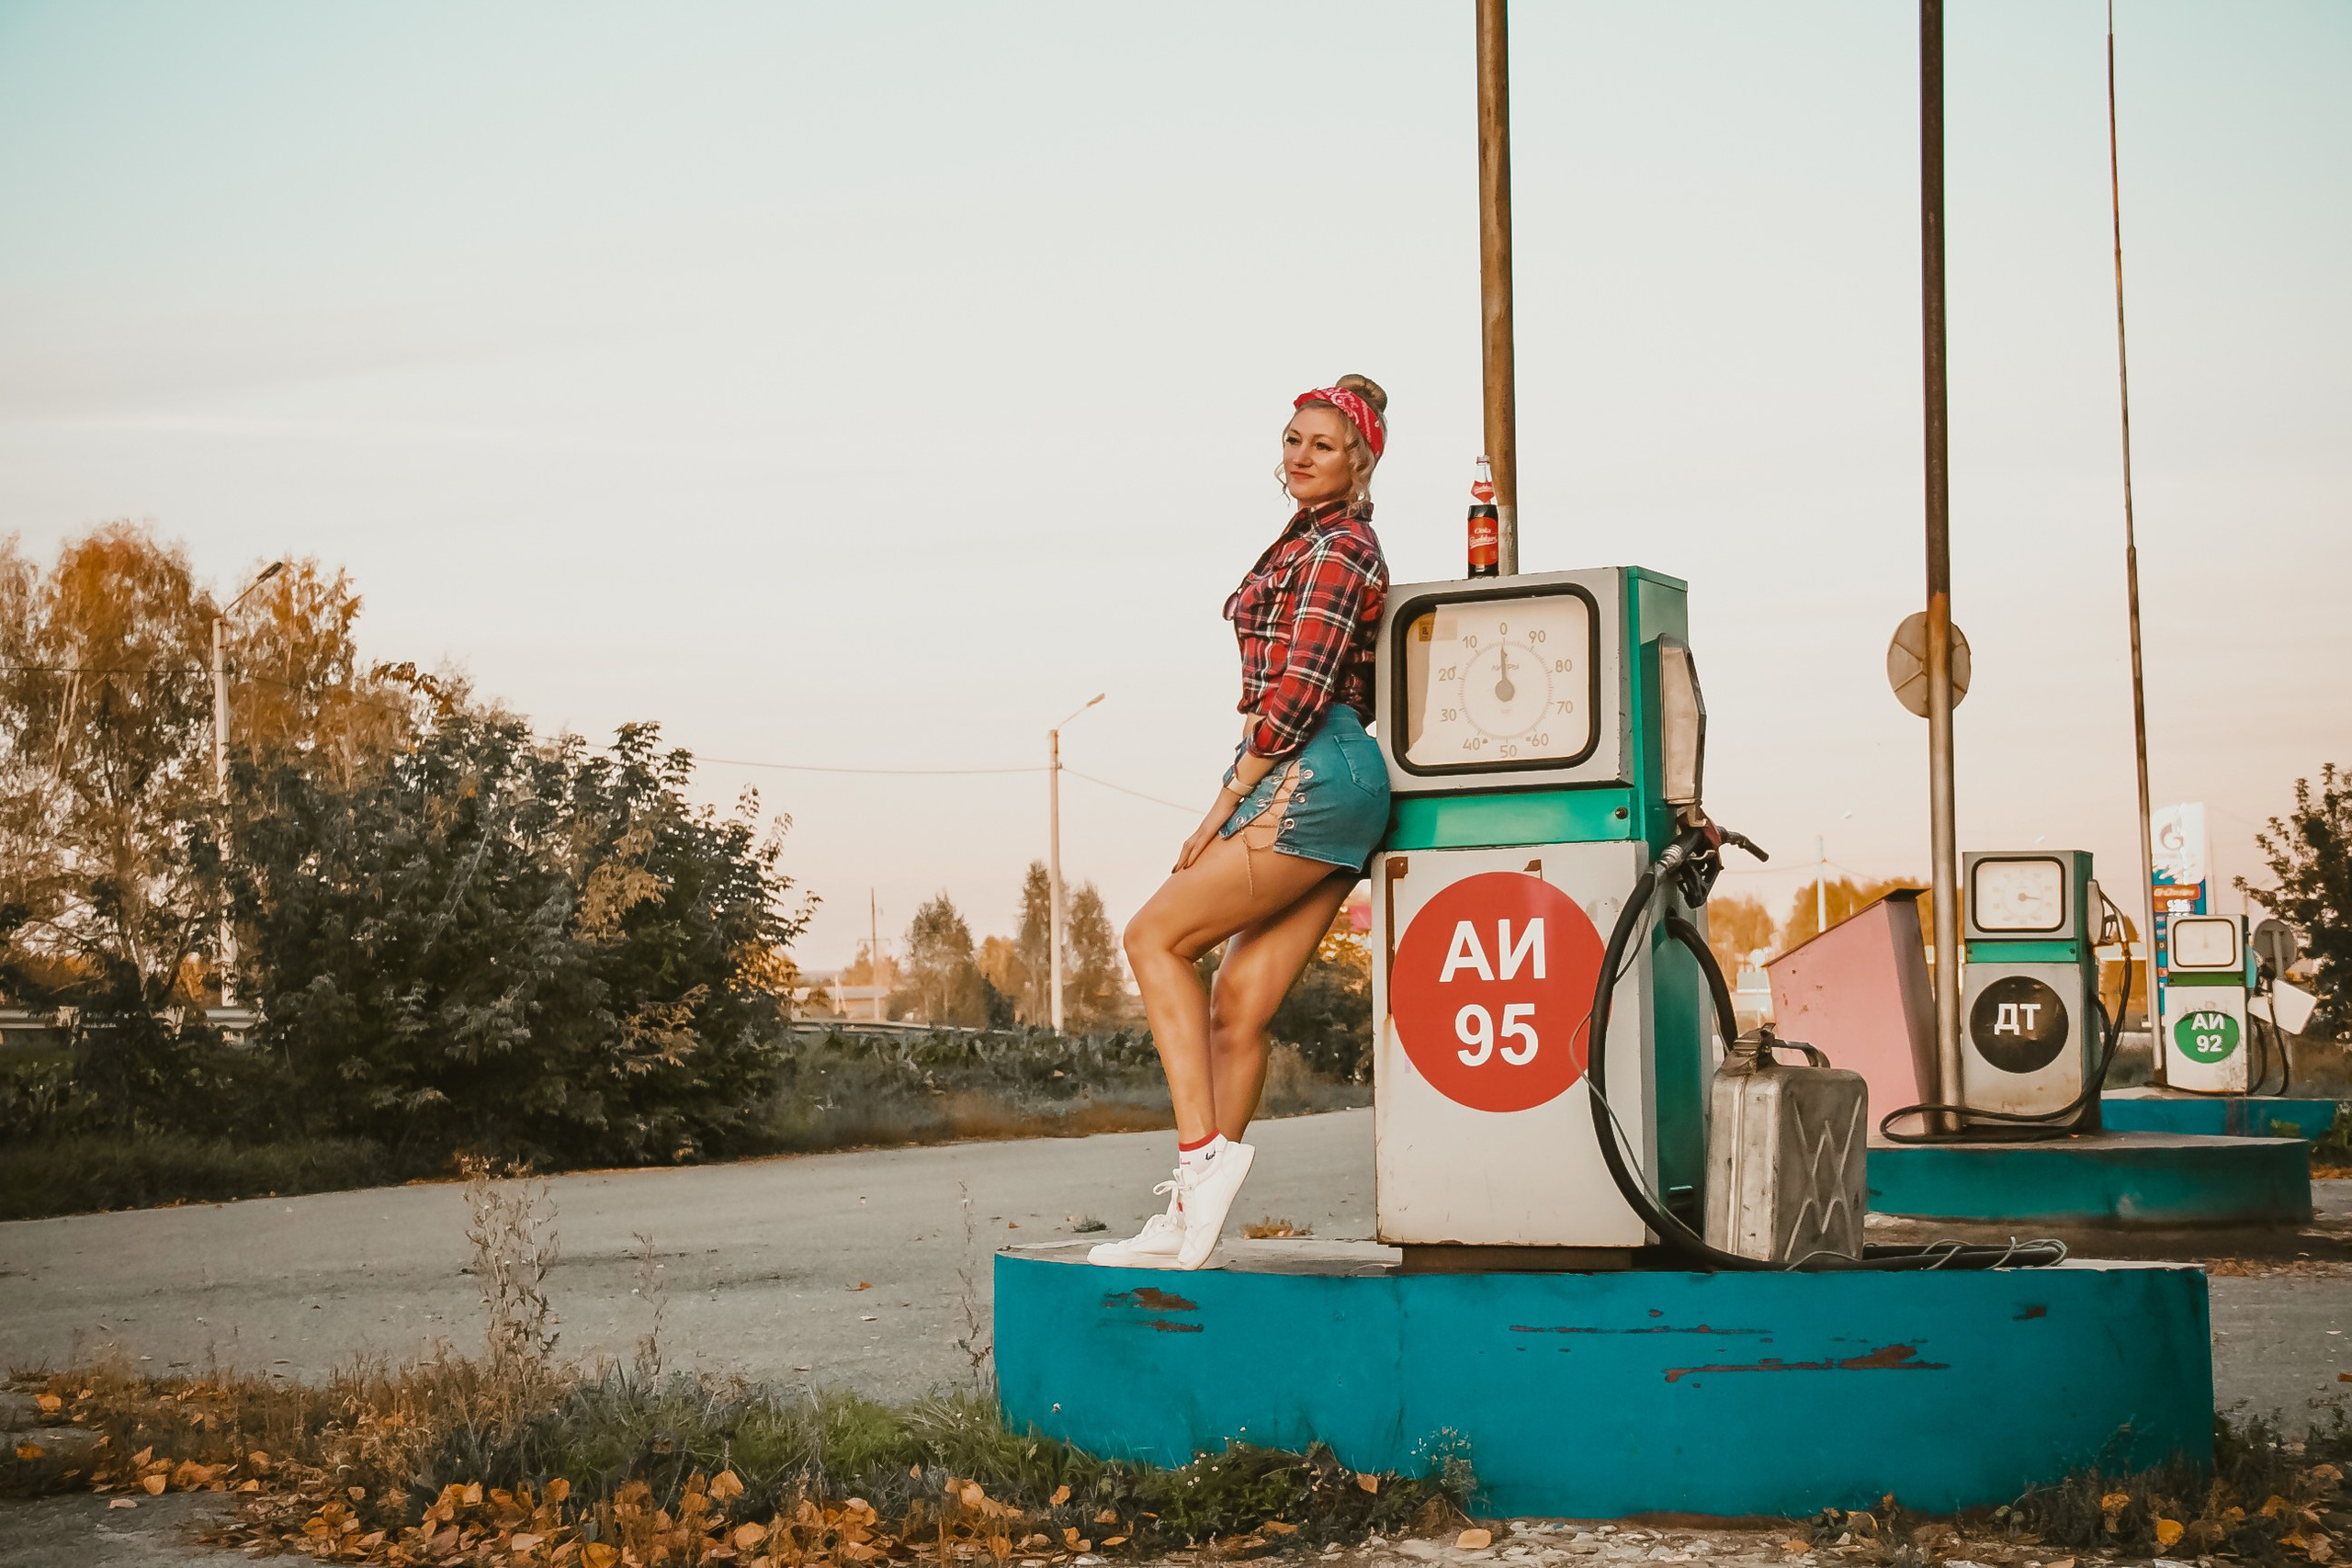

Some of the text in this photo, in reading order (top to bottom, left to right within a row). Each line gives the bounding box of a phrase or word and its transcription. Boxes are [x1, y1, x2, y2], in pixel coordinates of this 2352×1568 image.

[1498, 622, 1509, 636] 0
[1528, 629, 1546, 644] 90
[1462, 635, 1477, 649] 10
[1555, 659, 1573, 673] 80
[1438, 668, 1456, 682] 20
[1440, 708, 1457, 722] 30
[1556, 700, 1574, 715] 70
[1462, 737, 1481, 751] 40
[1532, 732, 1549, 747] 60
[1499, 744, 1518, 759] 50
[1440, 918, 1545, 982] АИ
[1994, 1003, 2041, 1035] ДТ
[2191, 1013, 2225, 1031] АИ
[1454, 1002, 1539, 1066] 95
[2196, 1034, 2222, 1053] 92
